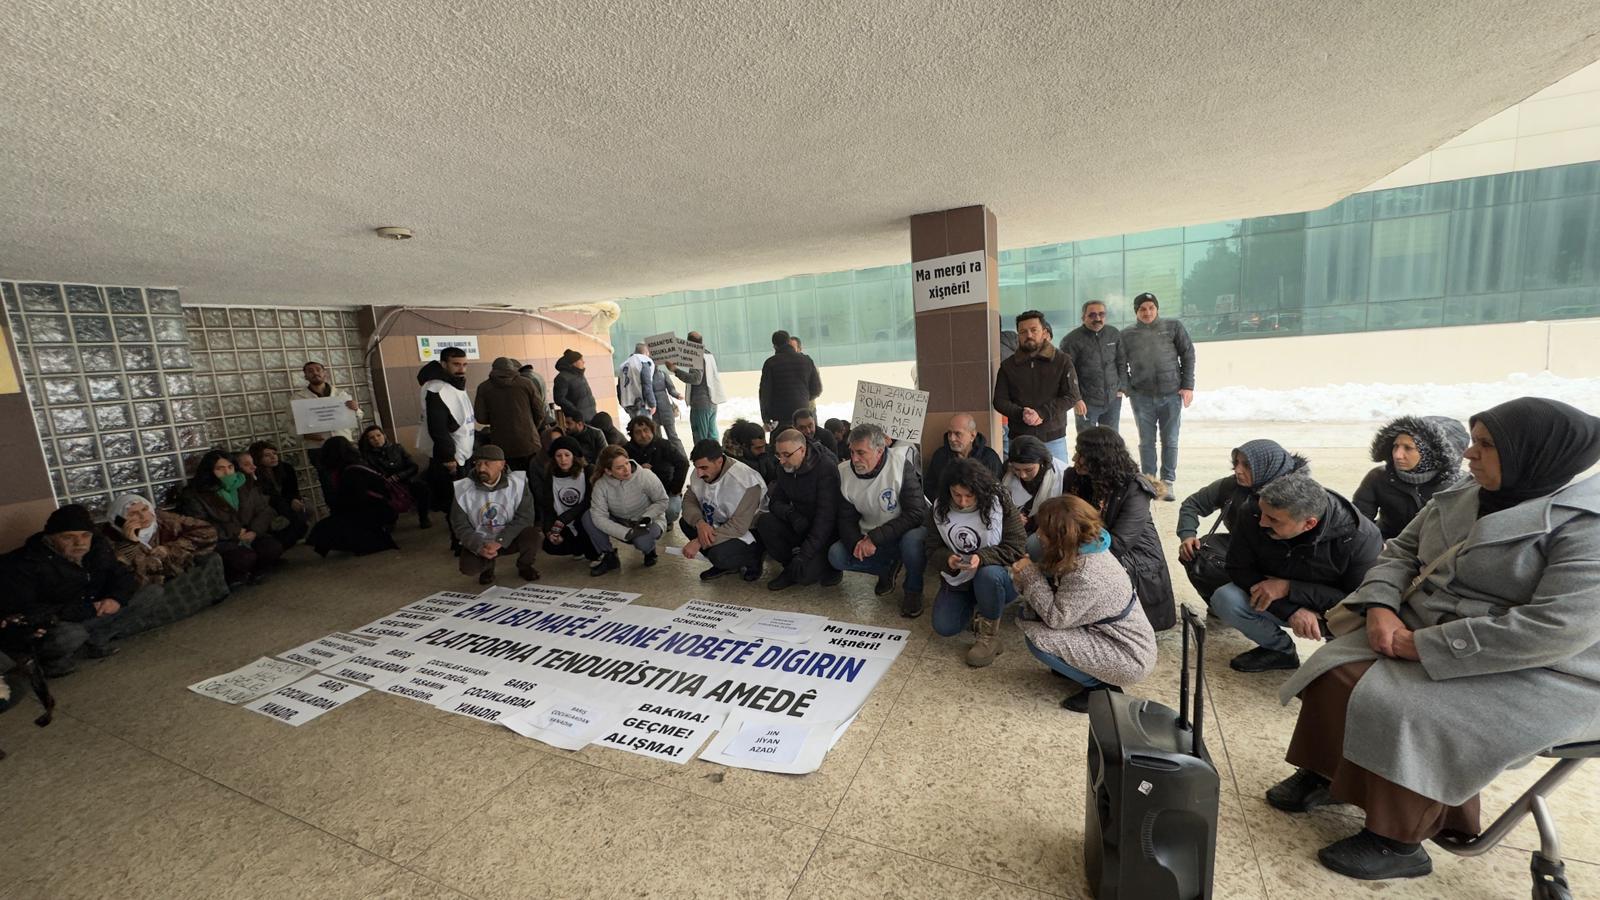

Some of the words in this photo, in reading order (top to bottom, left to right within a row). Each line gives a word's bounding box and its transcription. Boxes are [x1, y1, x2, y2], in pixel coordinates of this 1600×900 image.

[915, 269, 931, 282] Ma
[934, 261, 966, 279] mergî
[970, 261, 982, 273] ra
[928, 280, 970, 300] xişnêrî!
[893, 416, 911, 426] ME
[410, 604, 454, 614] ALIŞMA!
[426, 598, 467, 606] GEÇME!
[453, 602, 501, 620] EM
[685, 605, 712, 614] TARAFI
[689, 600, 724, 609] ÇOCUKLAR
[725, 605, 753, 613] SAVAŞIN
[396, 612, 440, 621] BAKMA!
[479, 606, 517, 623] JI
[497, 608, 543, 628] BO
[361, 627, 409, 637] ALIŞMA!
[380, 620, 424, 629] GEÇME!
[526, 614, 602, 638] MAFÊ
[823, 624, 842, 634] Ma
[845, 628, 886, 640] mergî
[580, 620, 672, 649] JIYANÊ
[385, 649, 416, 660] BARIŞ
[654, 631, 764, 665] NOBETÊ
[346, 655, 412, 674] ÇOCUKLARDAN
[414, 628, 543, 664] PLATFORMA
[532, 648, 708, 697] TENDURÎSTIYA
[702, 679, 817, 718] AMEDÊ
[427, 659, 461, 673] ÇOCUKLAR
[459, 666, 491, 677] SAVAŞIN
[752, 645, 867, 683] DIGIRIN
[416, 667, 444, 680] TARAFI
[318, 680, 349, 694] BARIŞ
[409, 677, 448, 690] YAŞAMIN
[503, 678, 538, 693] BARIŞ
[273, 687, 341, 711] ÇOCUKLARDAN
[454, 702, 502, 721] YANADIR.
[637, 703, 710, 724] BAKMA!
[622, 717, 695, 740] GEÇME!
[603, 732, 684, 758] ALIŞMA!
